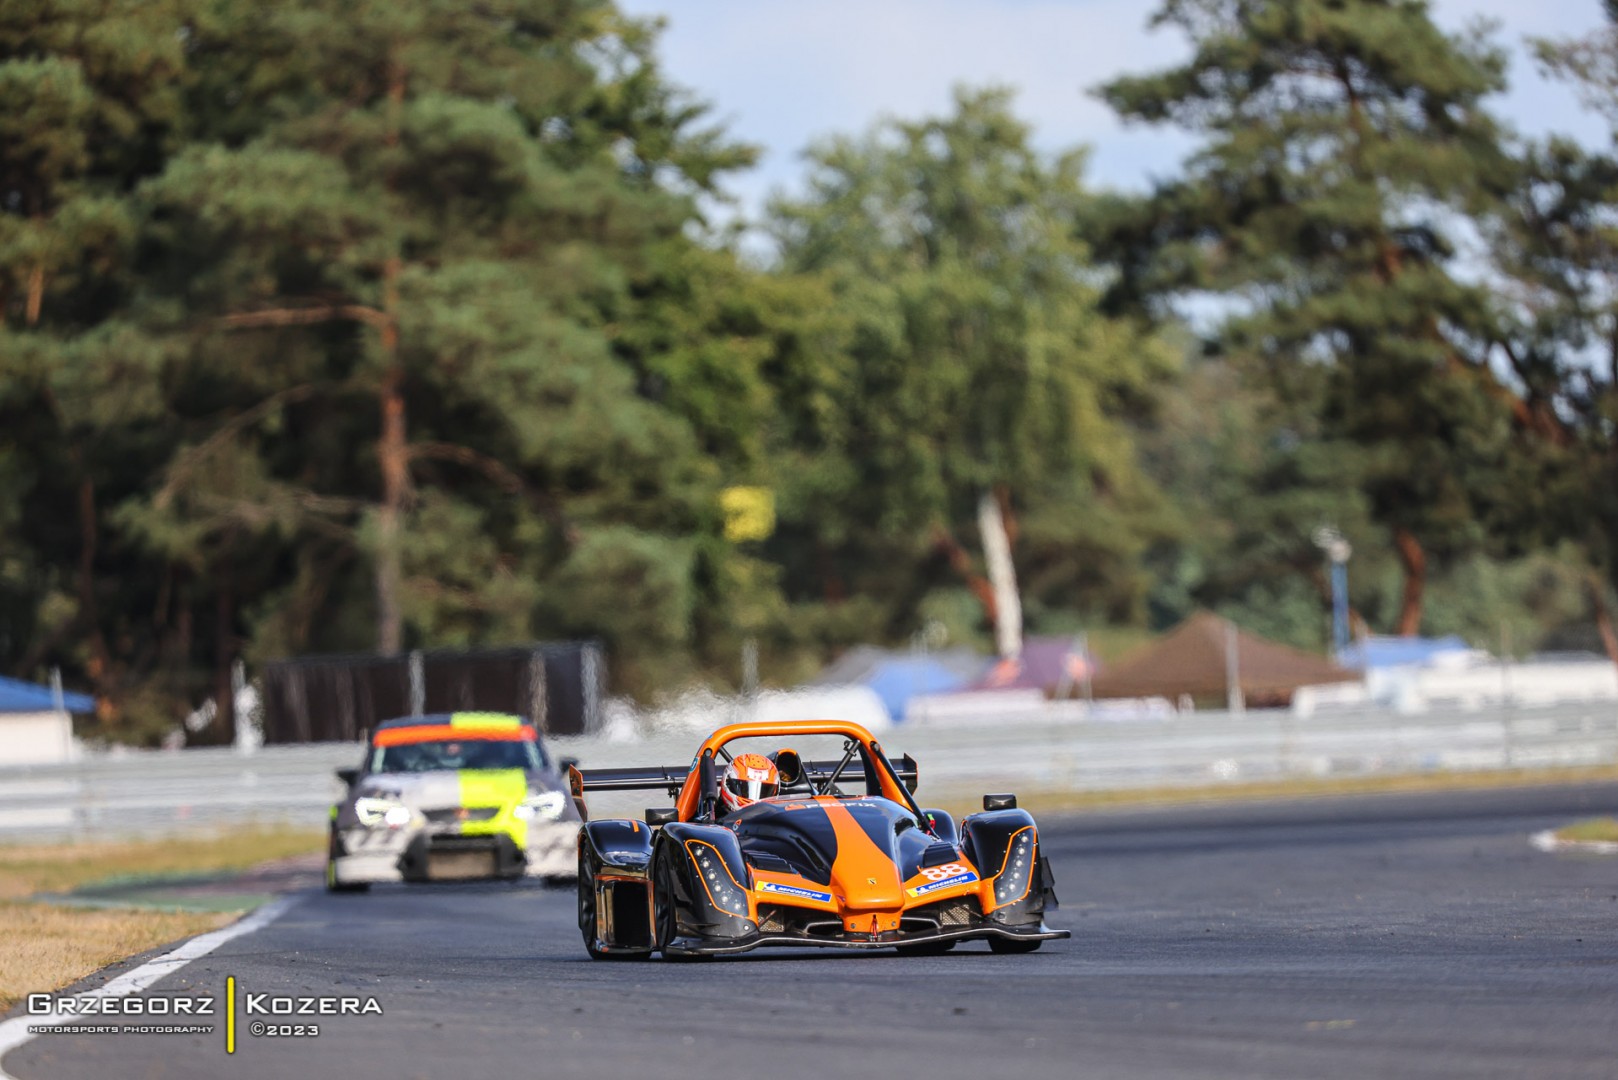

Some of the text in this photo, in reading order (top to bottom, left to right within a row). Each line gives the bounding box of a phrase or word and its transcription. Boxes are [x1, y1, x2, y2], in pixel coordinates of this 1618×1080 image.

[921, 864, 968, 881] 88
[928, 875, 968, 890] MICHELIN
[778, 886, 823, 898] MICHELIN
